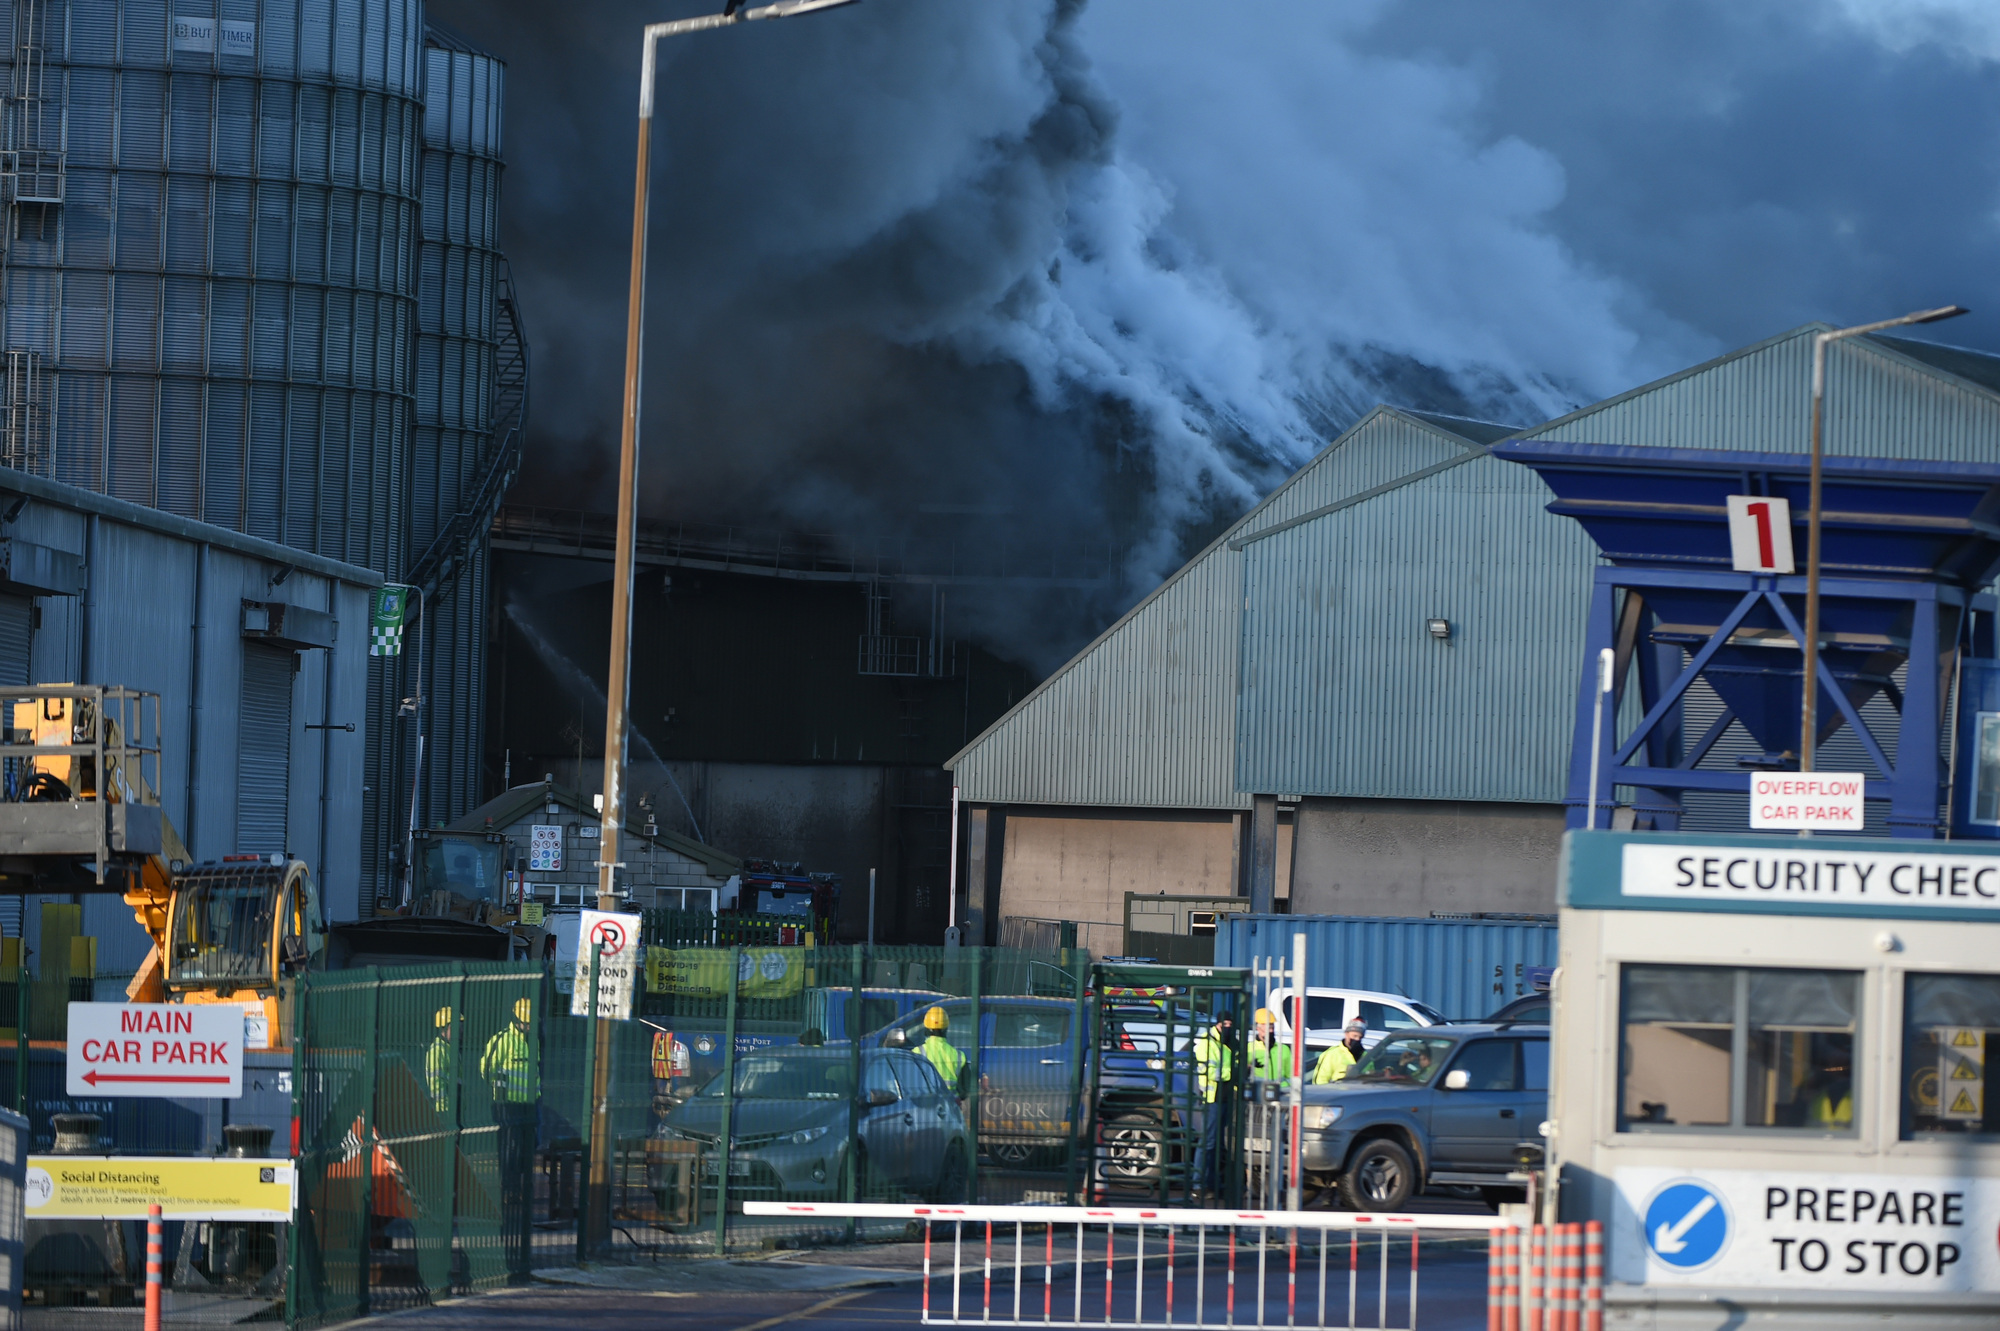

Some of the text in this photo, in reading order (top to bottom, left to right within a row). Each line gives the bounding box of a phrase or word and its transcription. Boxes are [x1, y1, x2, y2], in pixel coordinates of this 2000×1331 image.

[1747, 502, 1775, 568] 1
[1757, 780, 1859, 796] OVERFLOW
[1761, 804, 1854, 821] CAR PARK
[1676, 856, 1998, 898] SECURITY CHEC
[582, 965, 628, 979] BYOND
[658, 961, 698, 970] COVID-19
[657, 972, 688, 983] Social
[657, 982, 711, 994] Distancing
[583, 1001, 618, 1014] PINT
[121, 1010, 192, 1034] MAIN
[82, 1039, 228, 1065] CAR PARK
[985, 1097, 1049, 1119] CORK
[61, 1170, 160, 1186] Social Distancing
[1766, 1188, 1964, 1226] PREPARE
[1772, 1238, 1961, 1276] TO STOP
